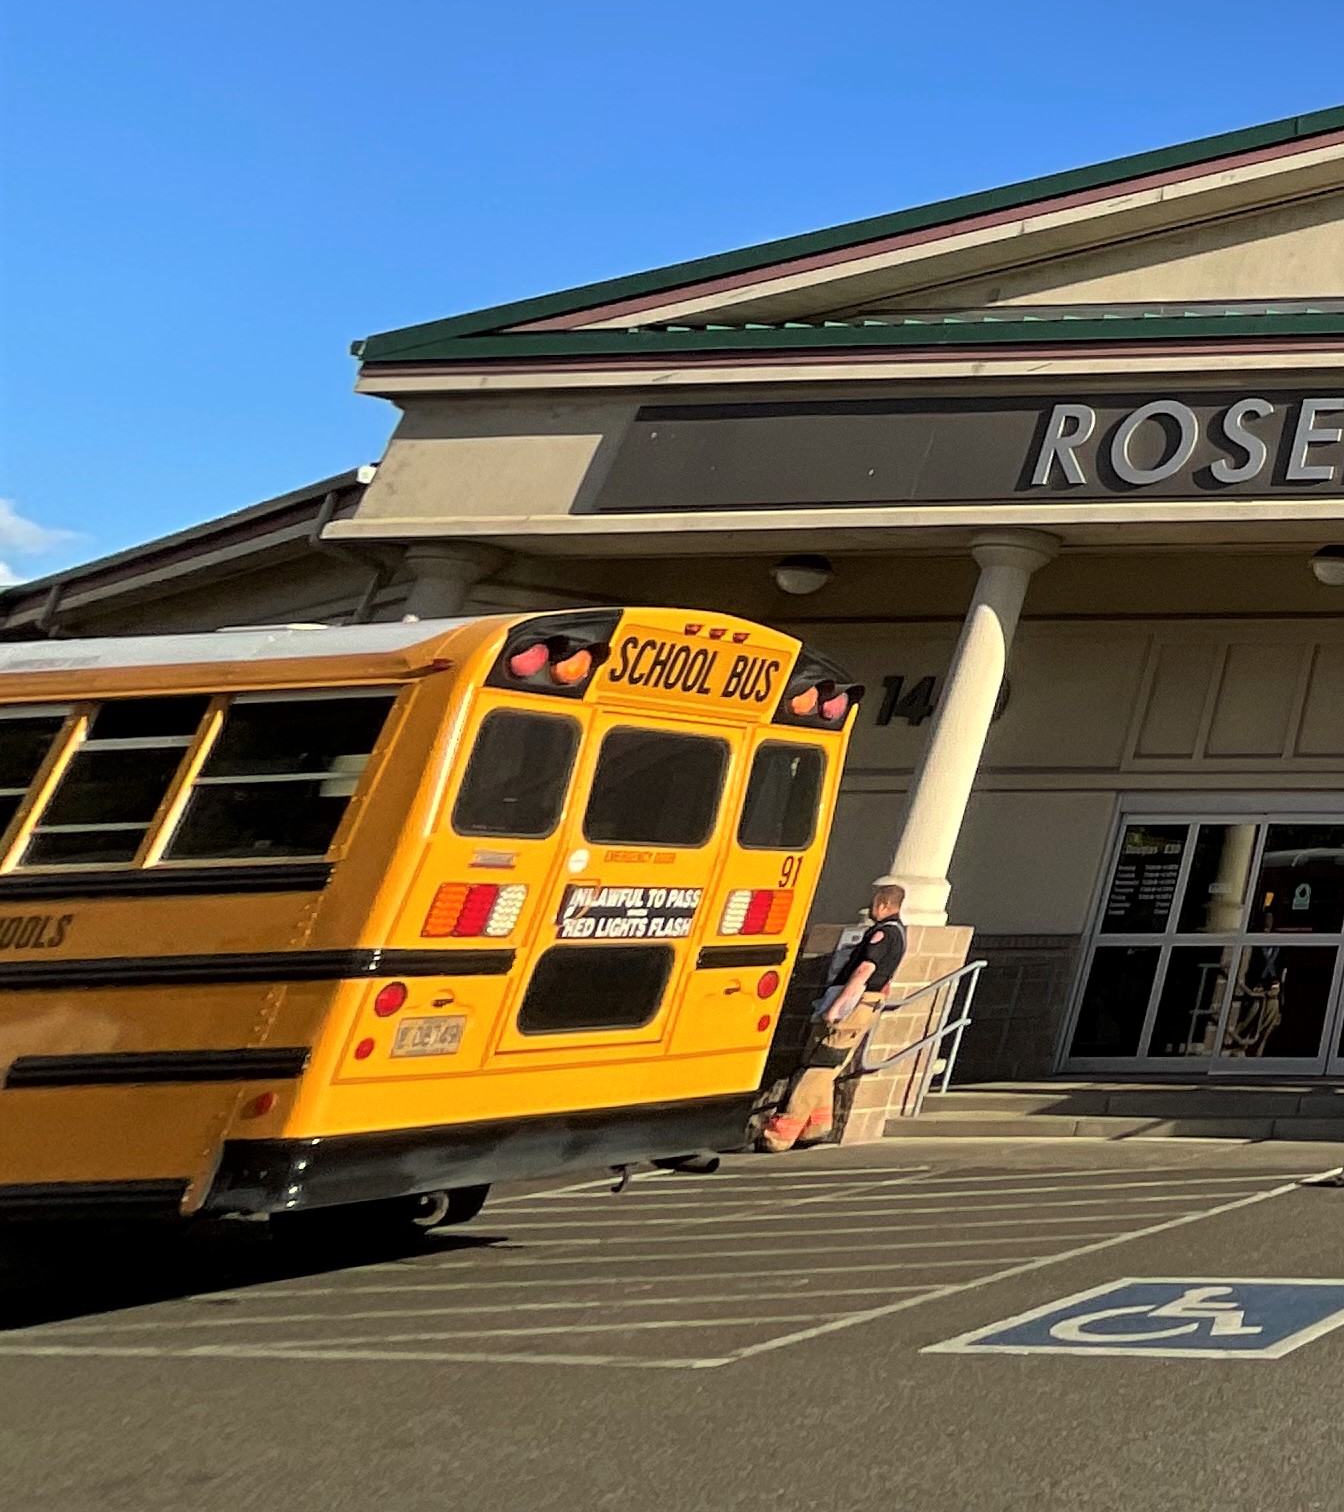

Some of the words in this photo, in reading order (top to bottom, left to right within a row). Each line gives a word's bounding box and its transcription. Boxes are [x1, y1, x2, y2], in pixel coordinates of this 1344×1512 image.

[609, 636, 719, 695] SCHOOL
[720, 654, 781, 702] BUS
[778, 855, 803, 888] 91
[646, 888, 667, 909] TO
[665, 888, 702, 909] PASS
[0, 914, 75, 949] OOLS
[561, 917, 596, 938] RED
[595, 917, 649, 938] LIGHTS
[647, 917, 692, 938] FLASH
